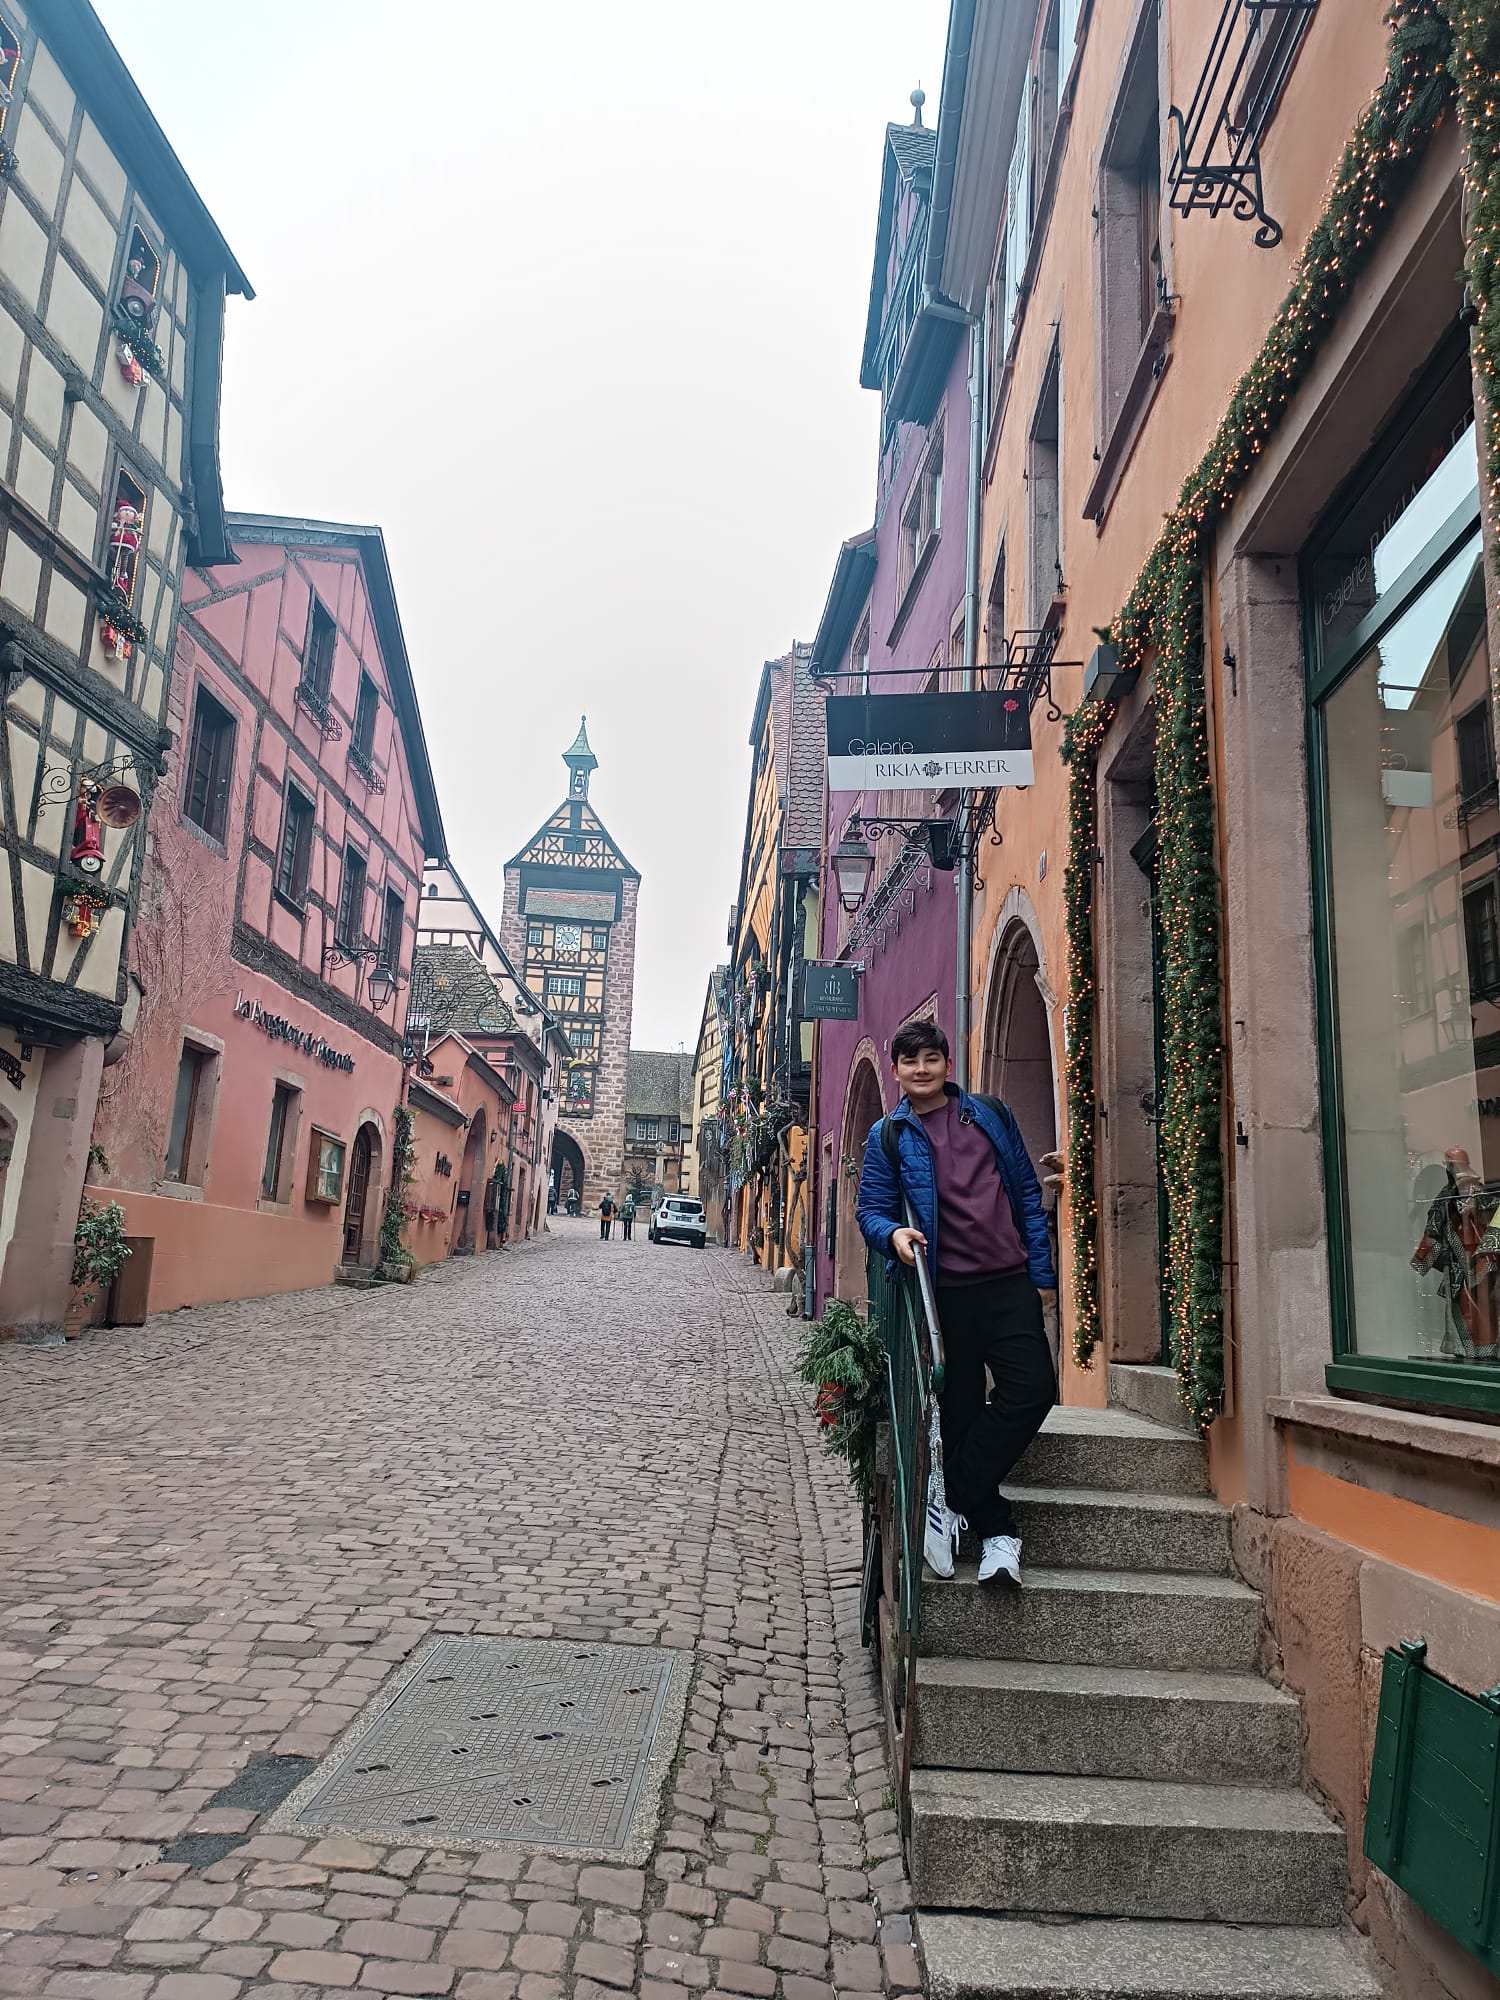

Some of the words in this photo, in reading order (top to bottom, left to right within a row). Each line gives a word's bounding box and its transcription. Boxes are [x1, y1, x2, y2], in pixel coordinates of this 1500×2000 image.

[1322, 556, 1368, 626] Galerie
[848, 738, 914, 756] Galerie
[875, 762, 921, 777] RIKIA
[945, 759, 1010, 776] FERRER
